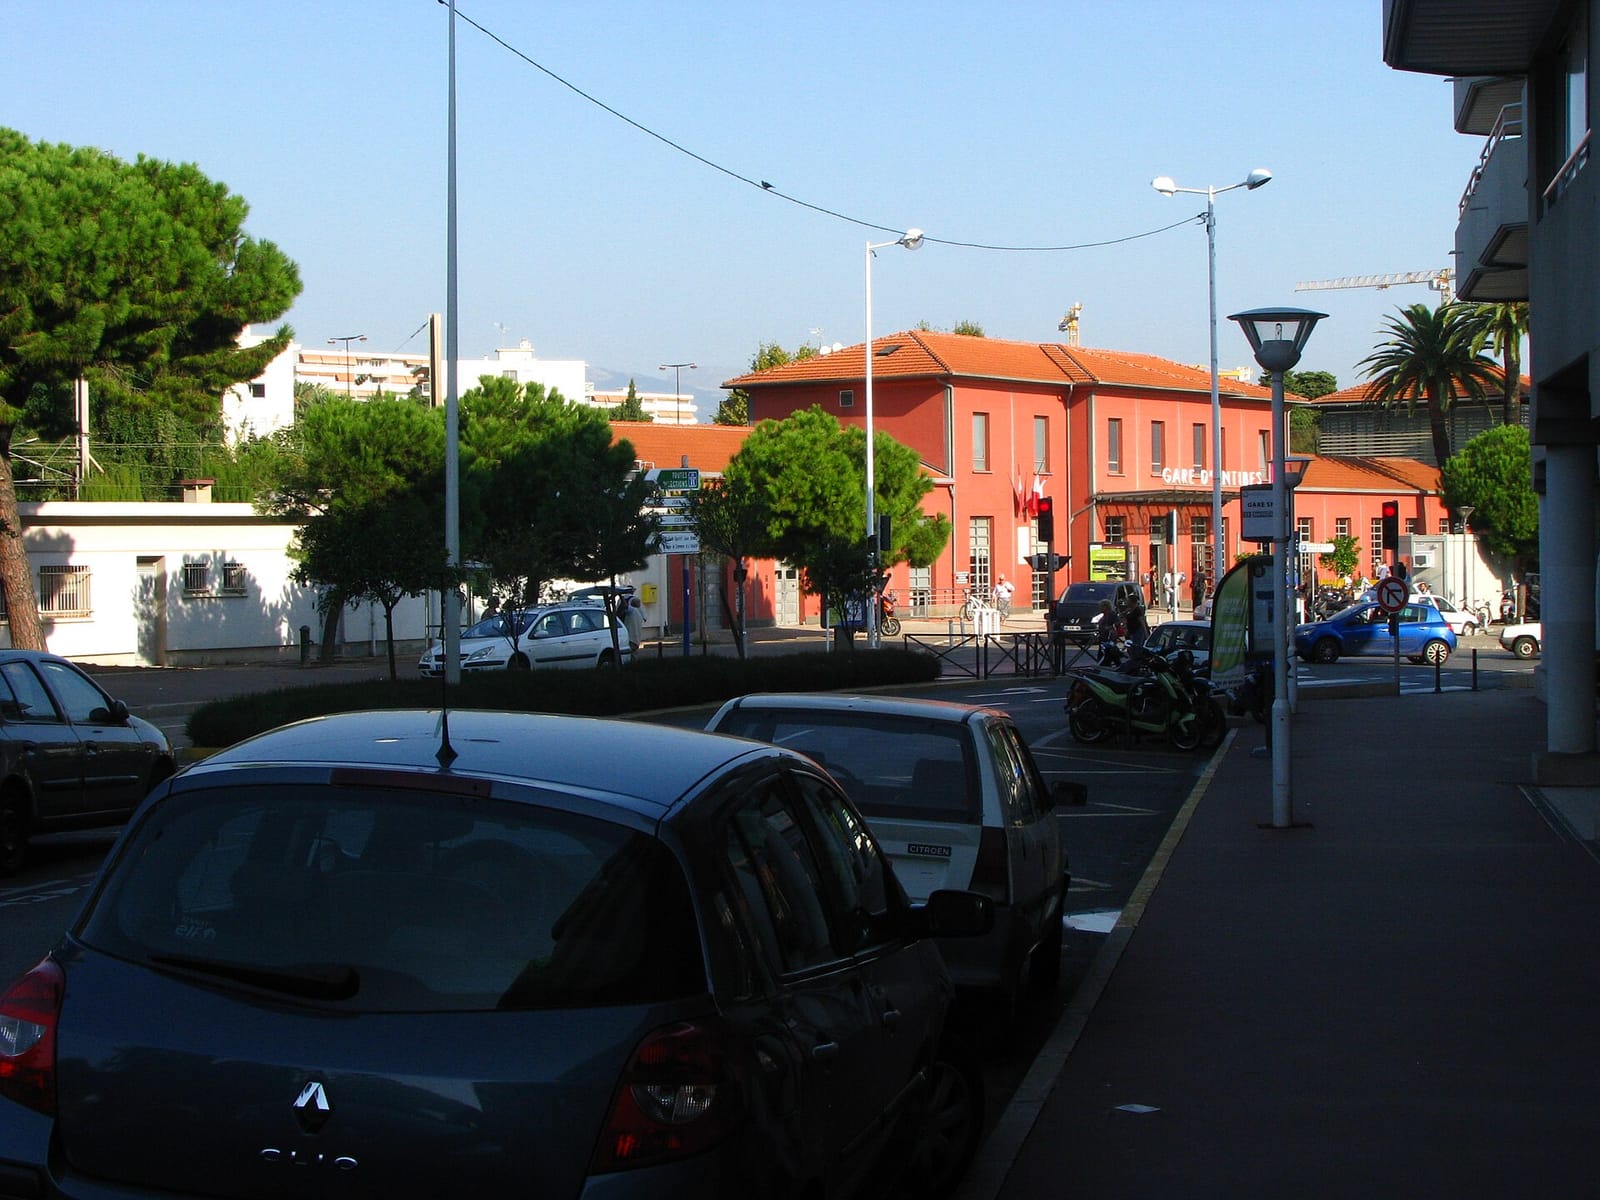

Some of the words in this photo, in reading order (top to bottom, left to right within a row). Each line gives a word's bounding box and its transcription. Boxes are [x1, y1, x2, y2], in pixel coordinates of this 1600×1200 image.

[1162, 467, 1195, 485] GARE
[1200, 469, 1262, 487] D'NTIBES
[910, 845, 949, 855] CITROEN
